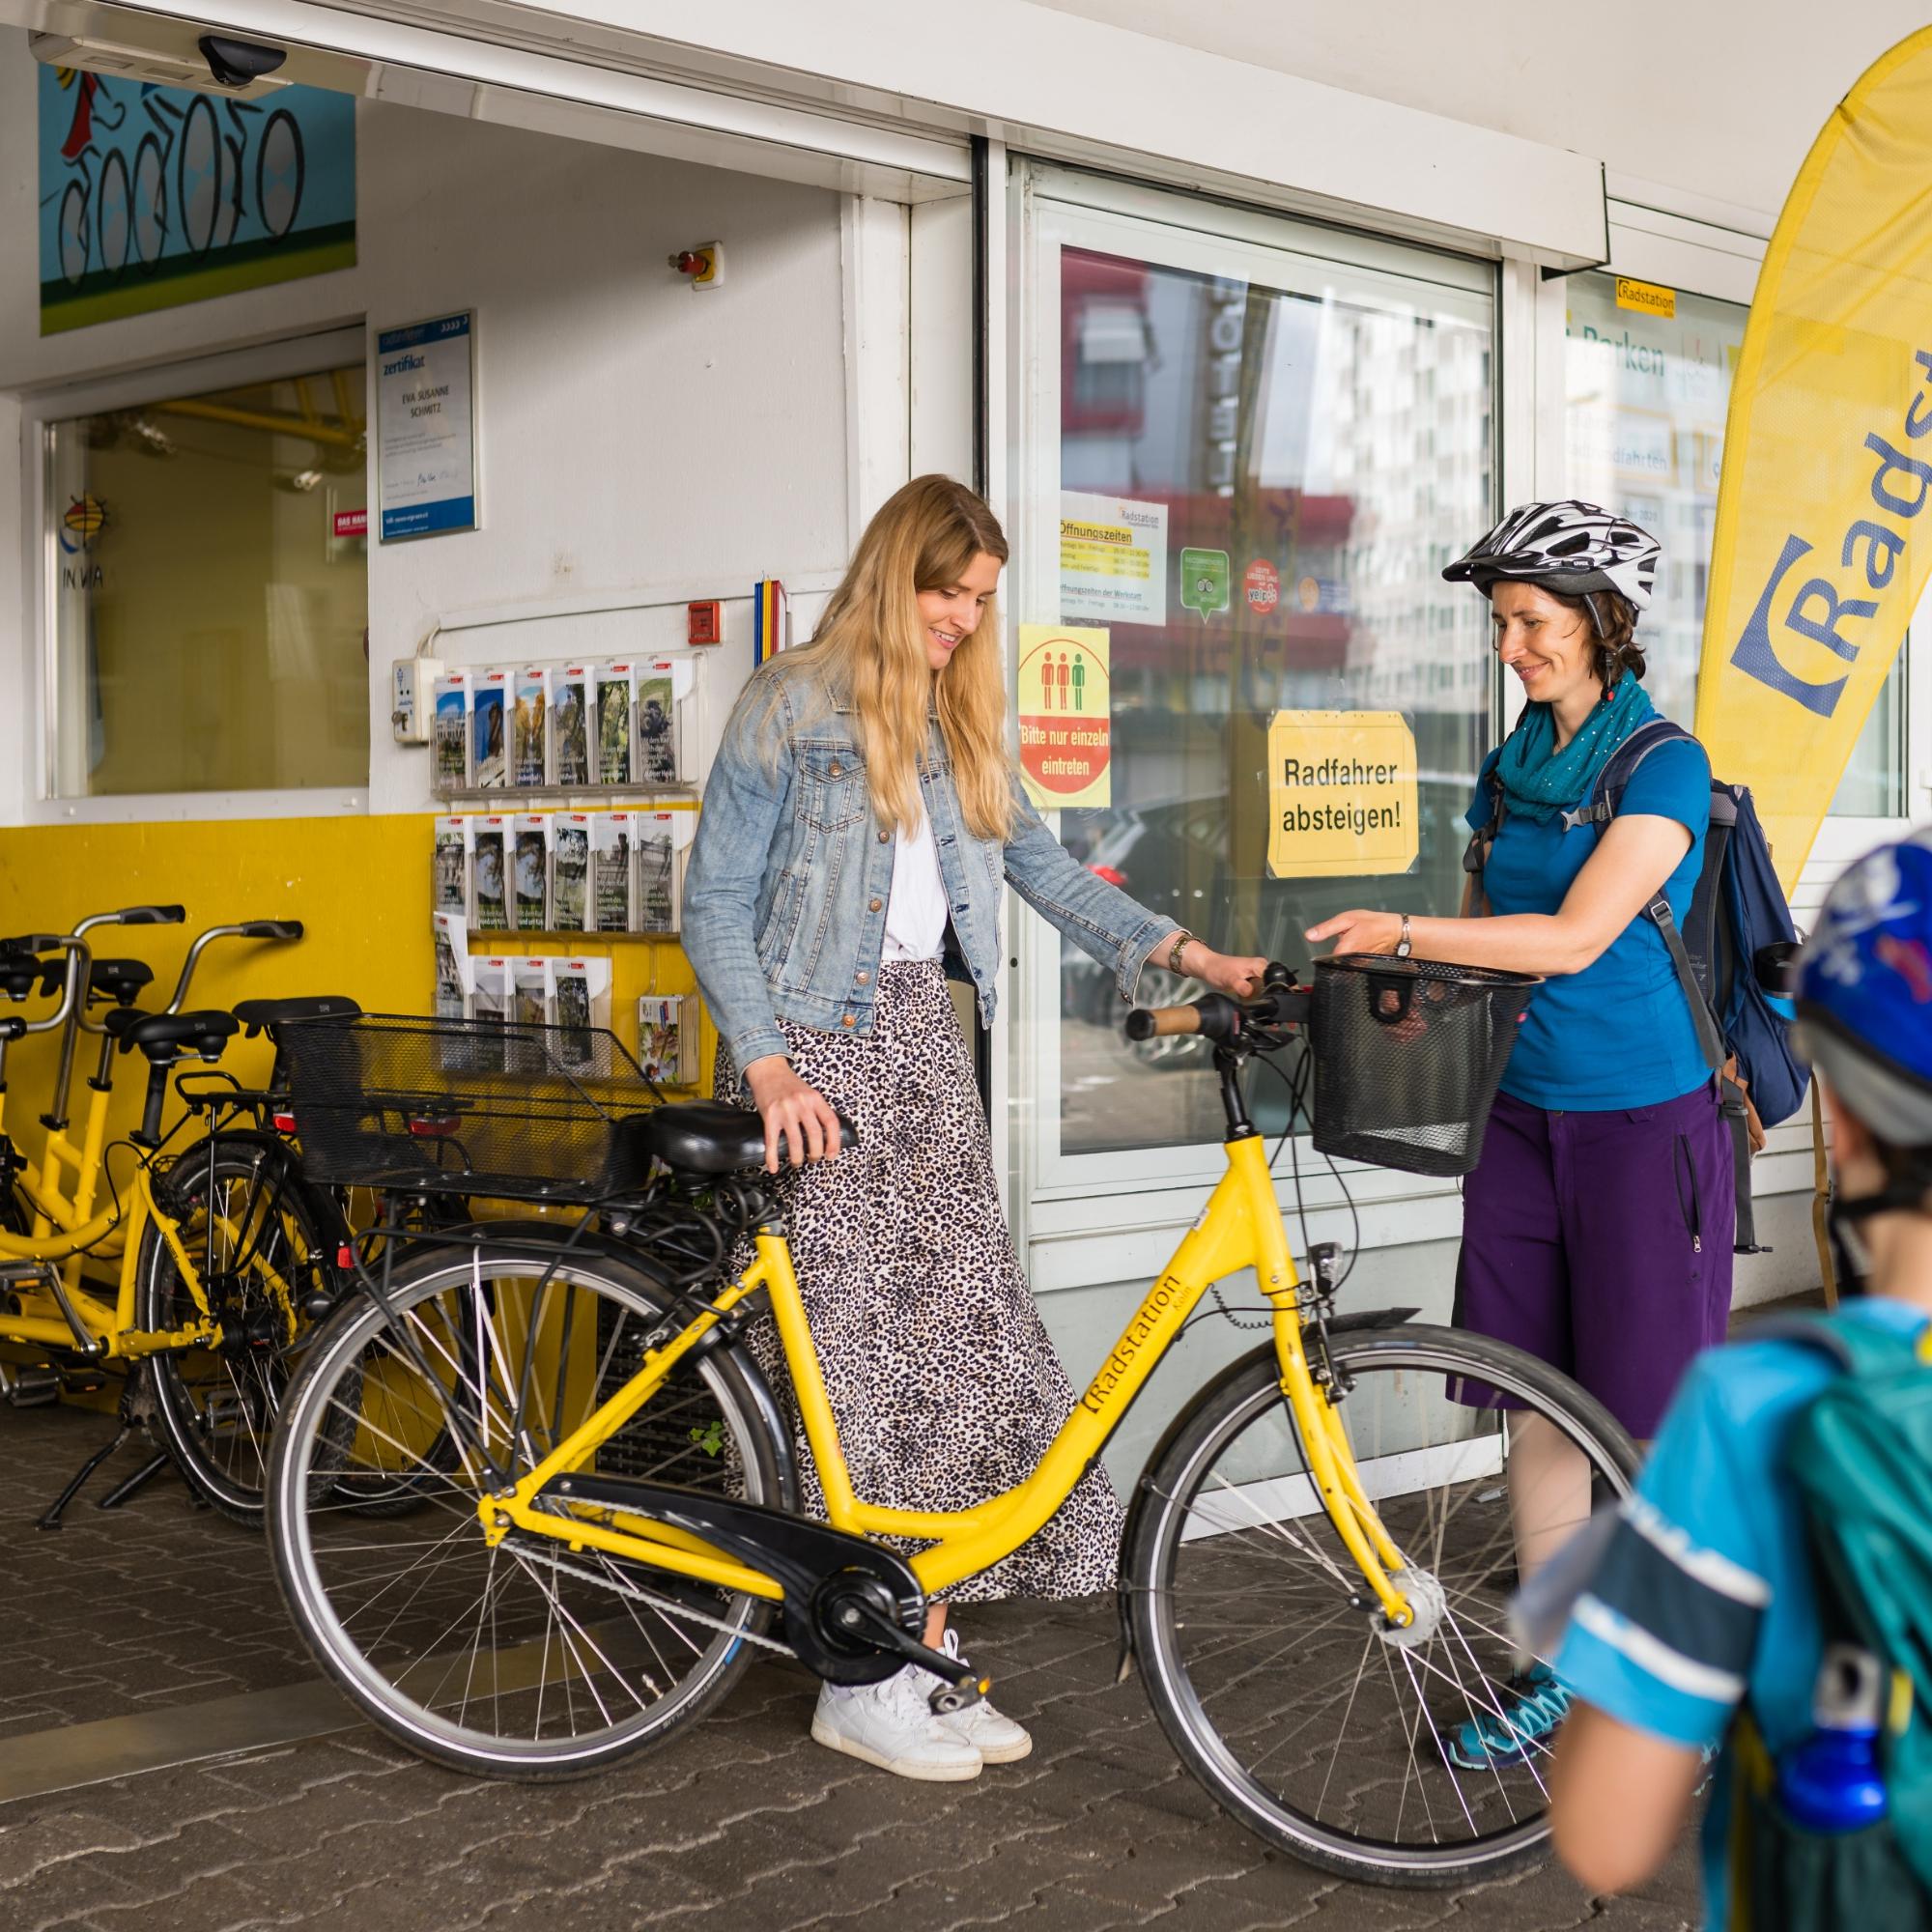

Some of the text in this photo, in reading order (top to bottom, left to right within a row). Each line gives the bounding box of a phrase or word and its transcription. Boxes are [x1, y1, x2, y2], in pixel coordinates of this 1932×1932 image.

[1622, 284, 1674, 310] Radstation
[384, 355, 425, 376] zertifikat
[402, 385, 449, 405] EVA SUSANNE
[410, 403, 441, 418] SCHMITZ
[1122, 509, 1159, 525] Radstation
[63, 567, 76, 589] IN
[1248, 587, 1268, 604] yelp
[1021, 725, 1109, 747] Bitte nur einzeln
[1041, 755, 1090, 776] eintreten
[1284, 758, 1398, 786] Radfahrer
[1283, 801, 1400, 836] absteigen!
[1090, 1275, 1180, 1405] Radstation
